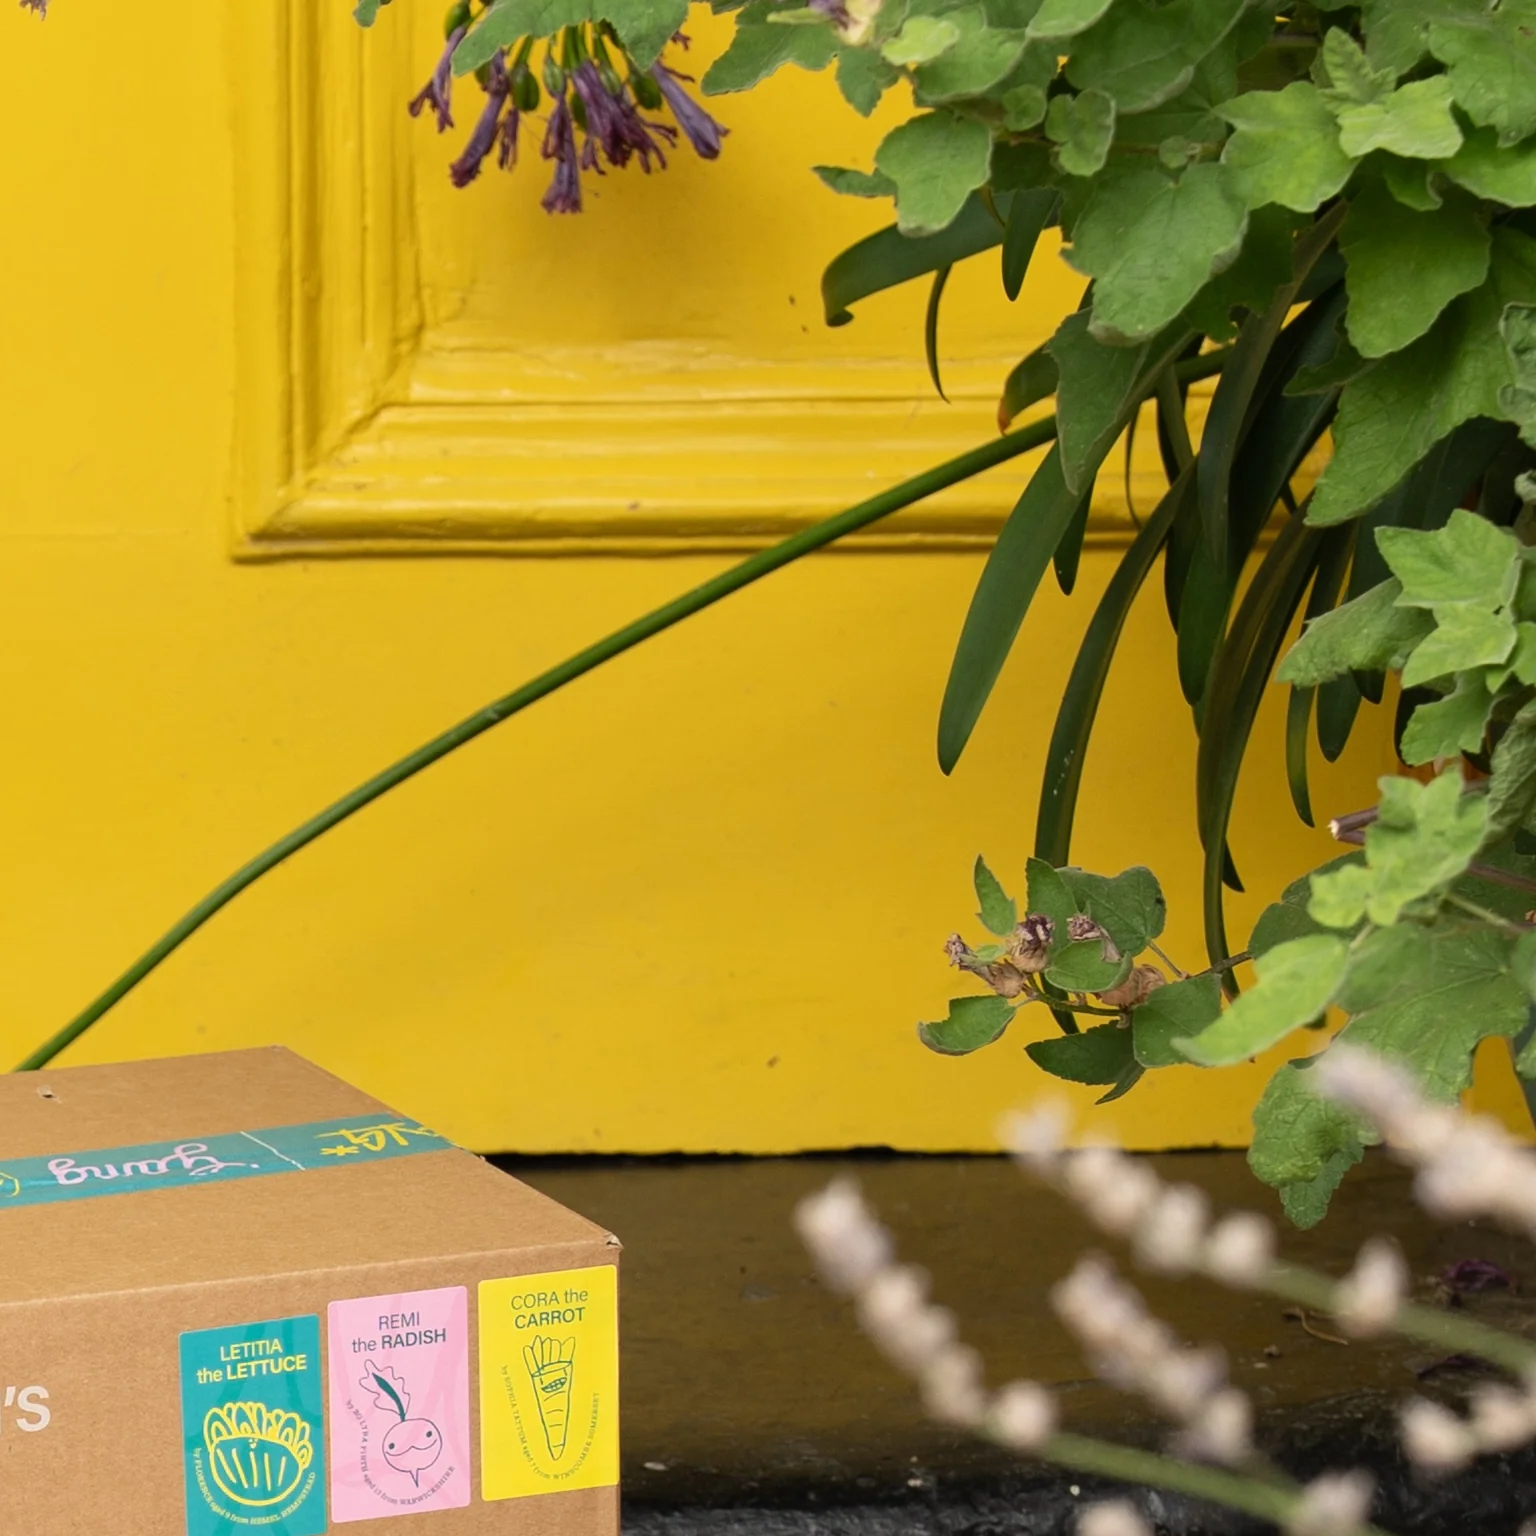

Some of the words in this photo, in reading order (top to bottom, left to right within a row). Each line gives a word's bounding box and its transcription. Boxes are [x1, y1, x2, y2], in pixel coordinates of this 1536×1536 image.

[511, 1293, 560, 1311] CORA
[564, 1288, 589, 1304] the
[379, 1312, 420, 1330] REMI
[514, 1307, 585, 1329] CARROT
[220, 1338, 283, 1361] LETITIA
[352, 1338, 376, 1353] the
[381, 1328, 446, 1349] RADISH
[196, 1367, 223, 1384] the
[227, 1354, 307, 1380] LETTUCE
